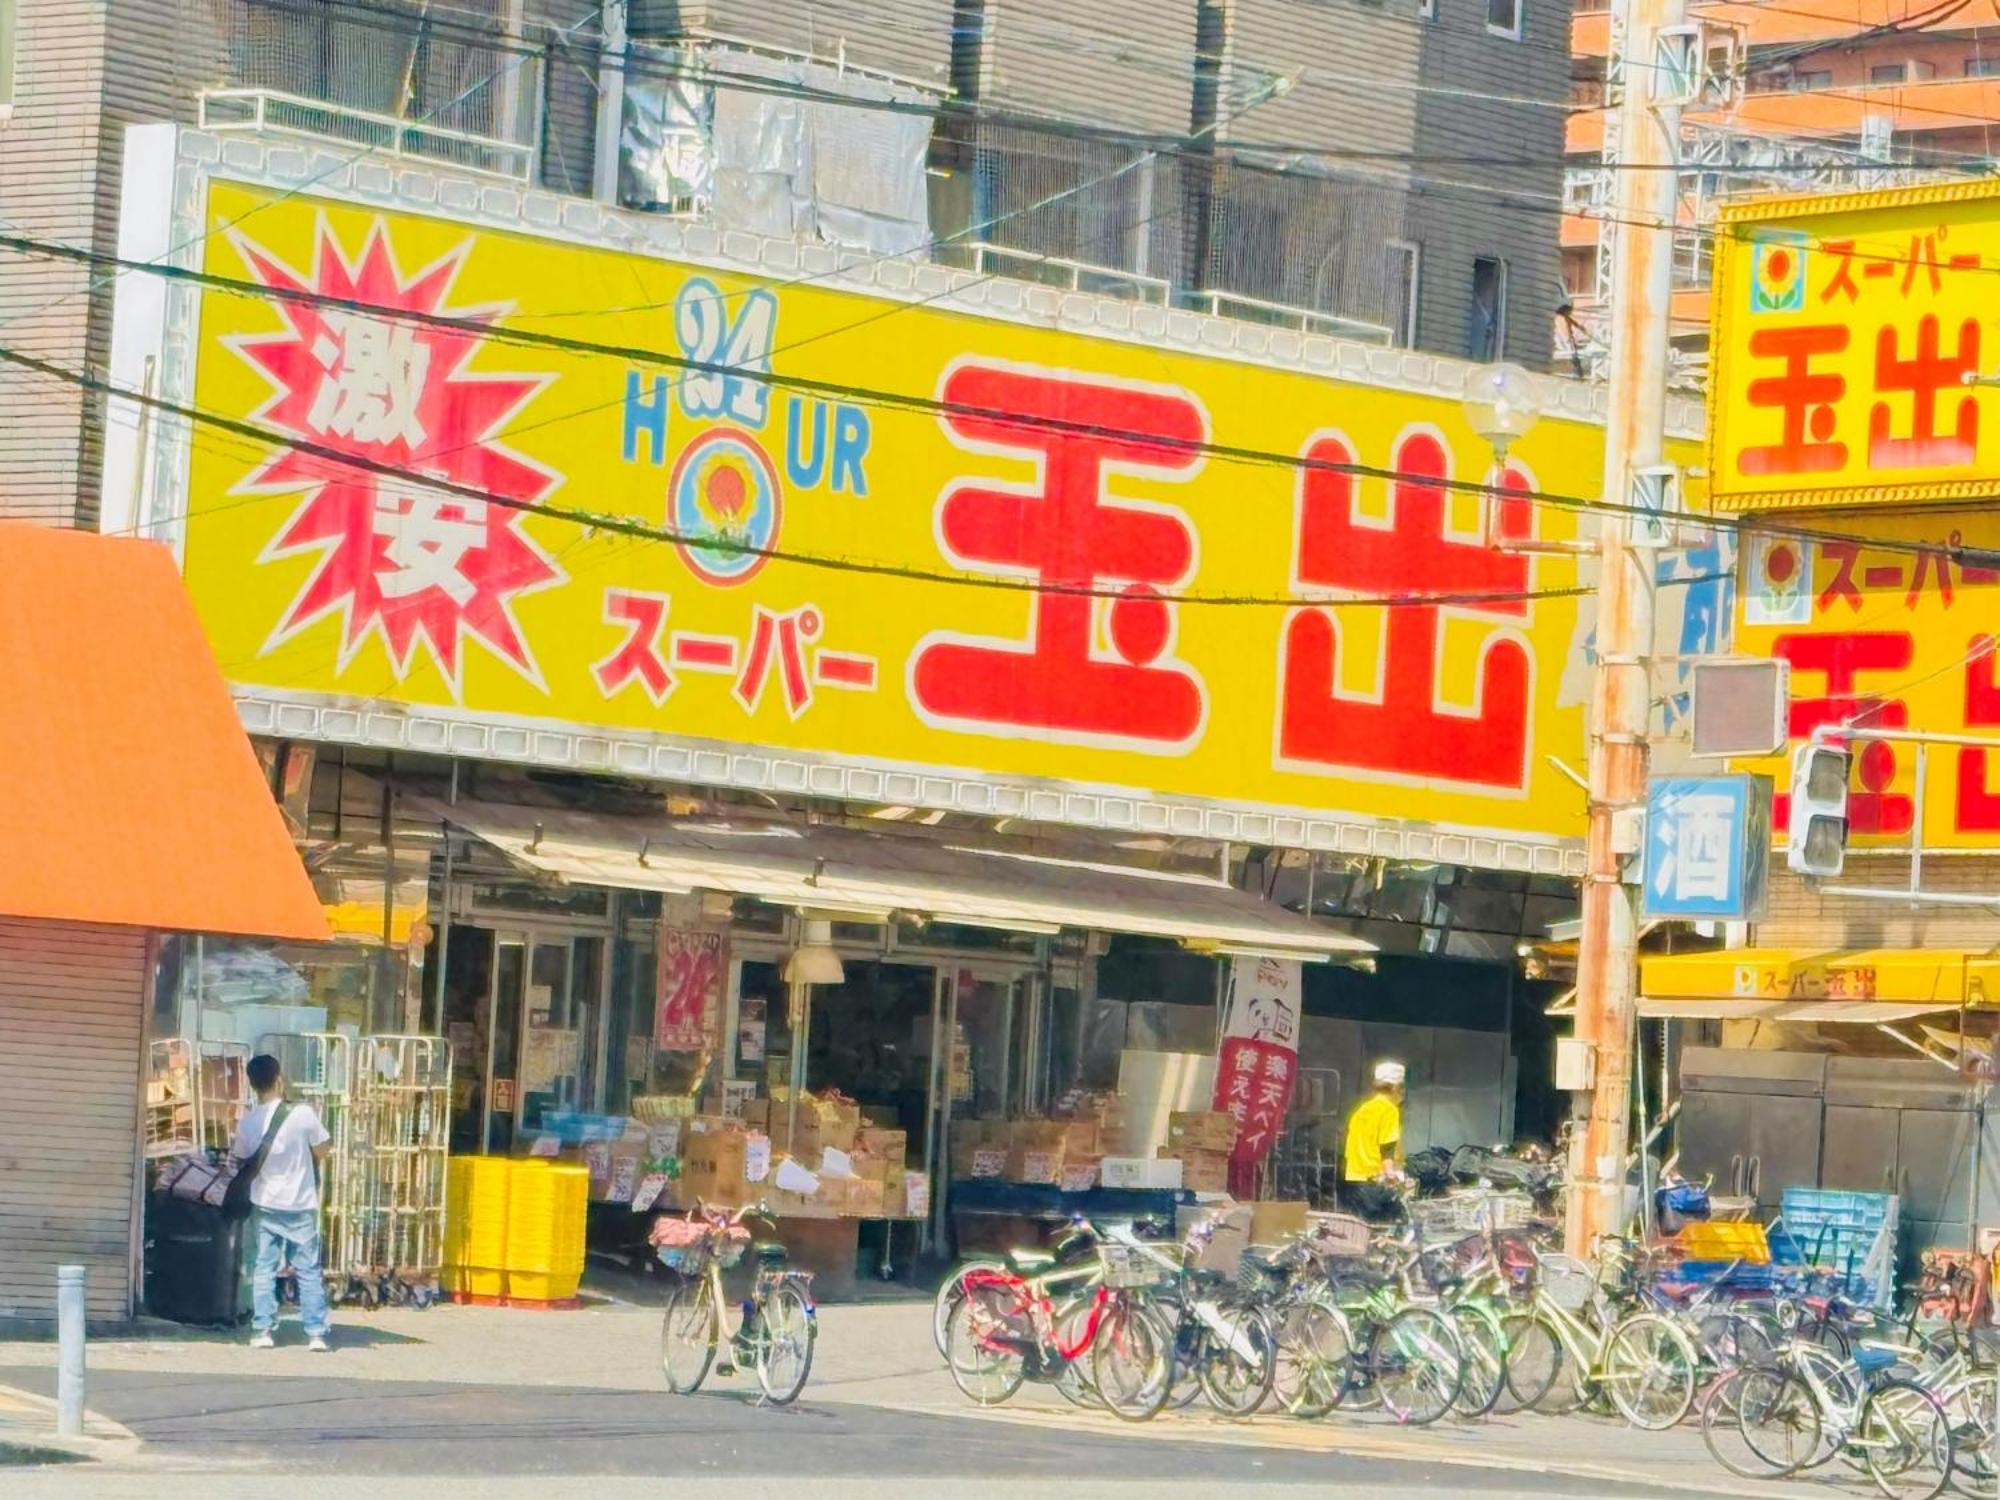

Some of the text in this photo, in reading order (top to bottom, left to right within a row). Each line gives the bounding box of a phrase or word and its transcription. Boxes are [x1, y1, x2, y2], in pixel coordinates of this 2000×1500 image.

[1820, 224, 1981, 305] スーパー
[674, 276, 779, 430] 24
[1736, 312, 1981, 477] 玉出
[306, 306, 489, 609] 激安
[591, 588, 879, 721] スーパー
[906, 353, 1539, 799] 玉出
[1816, 529, 2000, 614] スーパー
[1654, 794, 1735, 901] 酒
[1246, 1055, 1289, 1153] 楽天ペイ
